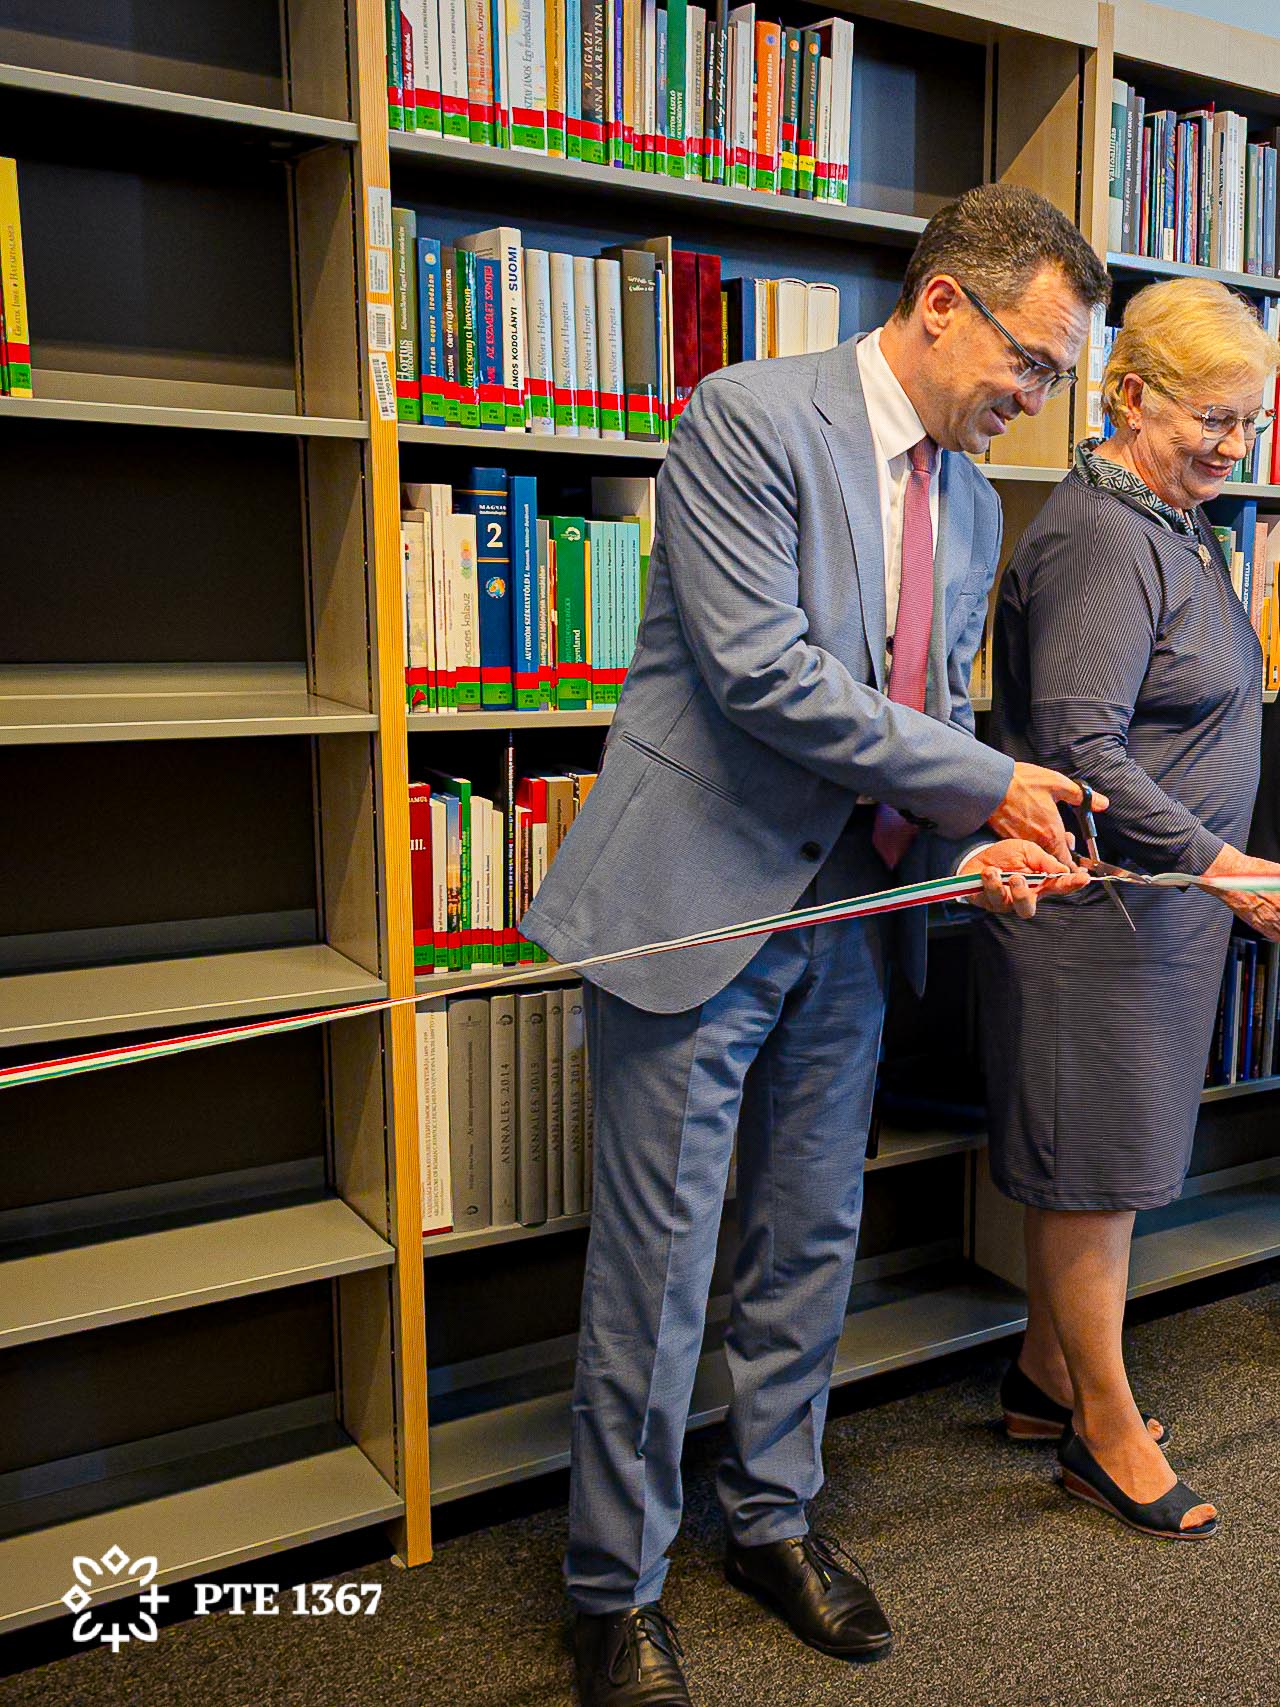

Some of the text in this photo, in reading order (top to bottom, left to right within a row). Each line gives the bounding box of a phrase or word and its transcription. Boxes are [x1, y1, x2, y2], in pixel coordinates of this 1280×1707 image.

[584, 31, 593, 90] AZ IGAZI
[594, 4, 603, 123] ANNA KARENYINA
[463, 288, 472, 330] havason
[484, 302, 495, 345] ESZMÉLET
[508, 246, 519, 388] ÁNOS KODOLÁNYI SUOMI
[486, 346, 496, 360] AZ
[487, 366, 496, 385] MRE
[486, 522, 504, 548] 2
[572, 630, 582, 663] genland
[500, 1063, 510, 1164] ANNALES 2014
[531, 1098, 542, 1163] ANNALES
[552, 1092, 560, 1154] ANNALES
[572, 1092, 581, 1154] ANNALES
